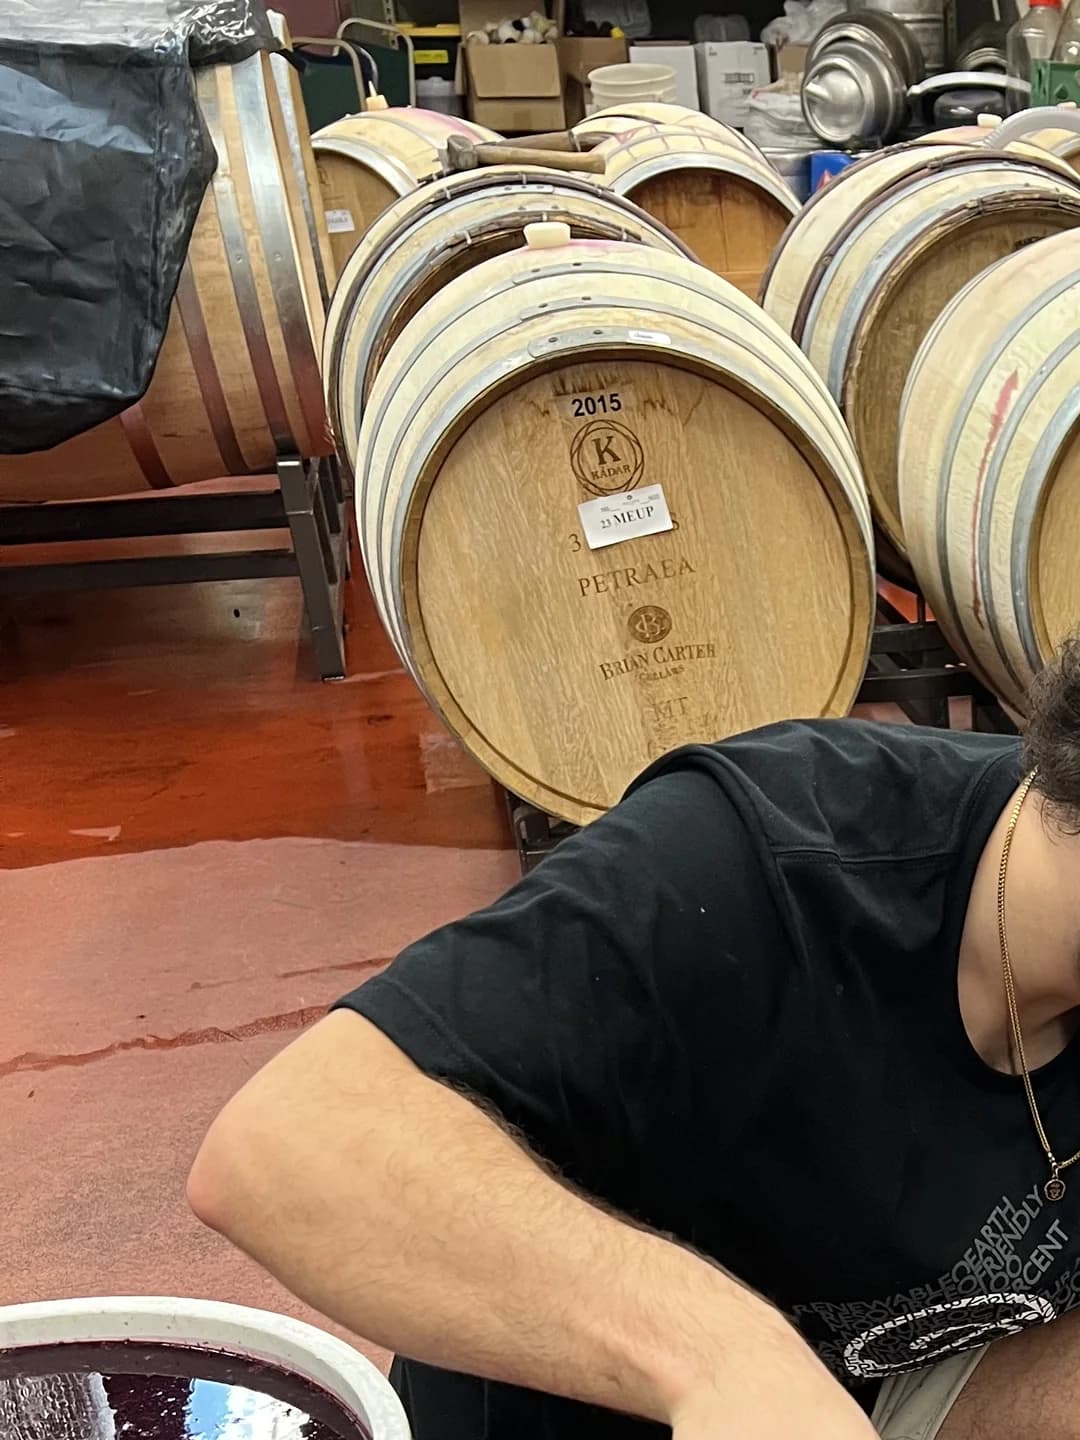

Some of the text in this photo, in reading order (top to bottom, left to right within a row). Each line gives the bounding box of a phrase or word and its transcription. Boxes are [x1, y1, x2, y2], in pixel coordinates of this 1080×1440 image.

[571, 393, 622, 417] 2015
[613, 505, 654, 525] MEUP
[577, 556, 697, 597] PETRAEA
[599, 643, 717, 681] BRIAN CARTER
[965, 1195, 1019, 1272] EARTH
[977, 1184, 1046, 1283] FRIENDLY
[791, 1271, 954, 1315] RENEWABLE
